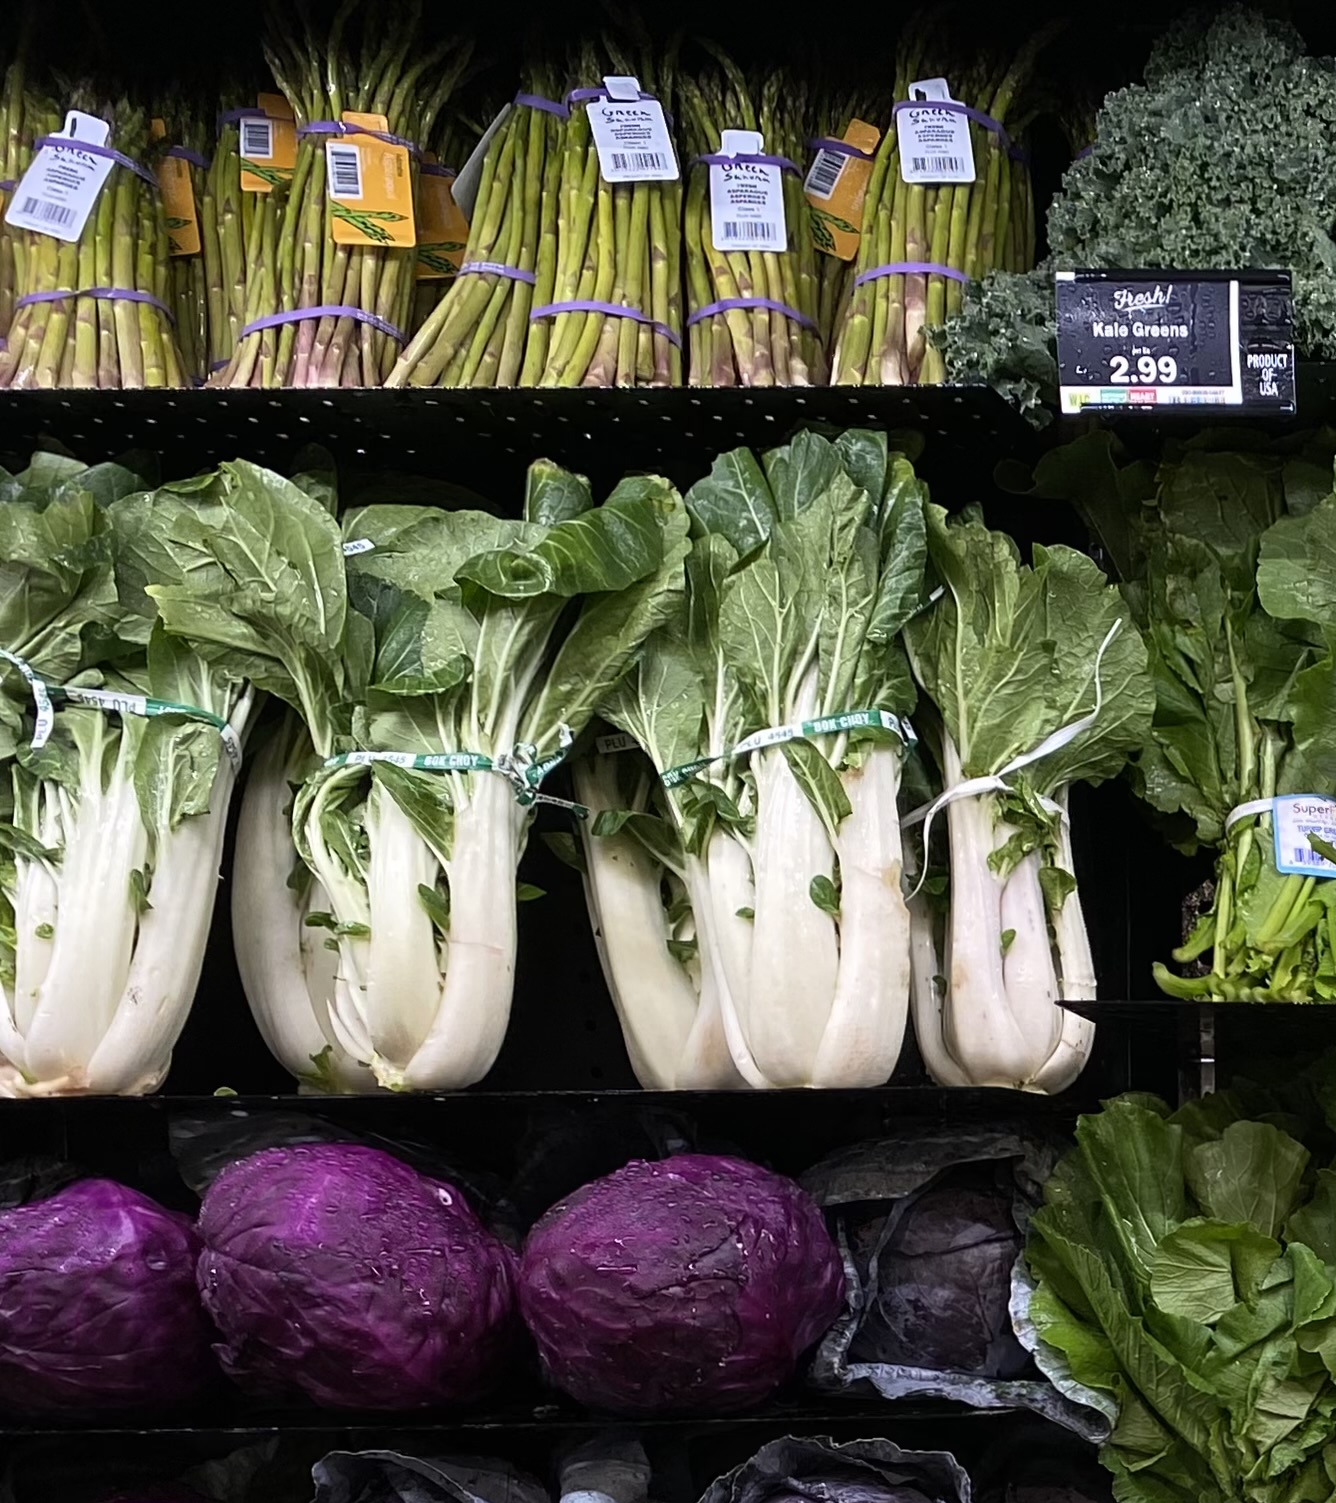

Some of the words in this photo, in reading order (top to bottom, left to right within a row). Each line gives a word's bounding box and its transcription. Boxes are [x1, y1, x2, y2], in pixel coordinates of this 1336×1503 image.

[1113, 284, 1173, 310] Fresh!
[1093, 322, 1129, 338] Kale
[1132, 322, 1189, 338] Greens
[1246, 353, 1288, 368] PRODUCT
[1109, 355, 1178, 383] 2.99
[1261, 368, 1277, 381] OF
[1259, 381, 1279, 396] USA
[604, 737, 626, 749] PLU
